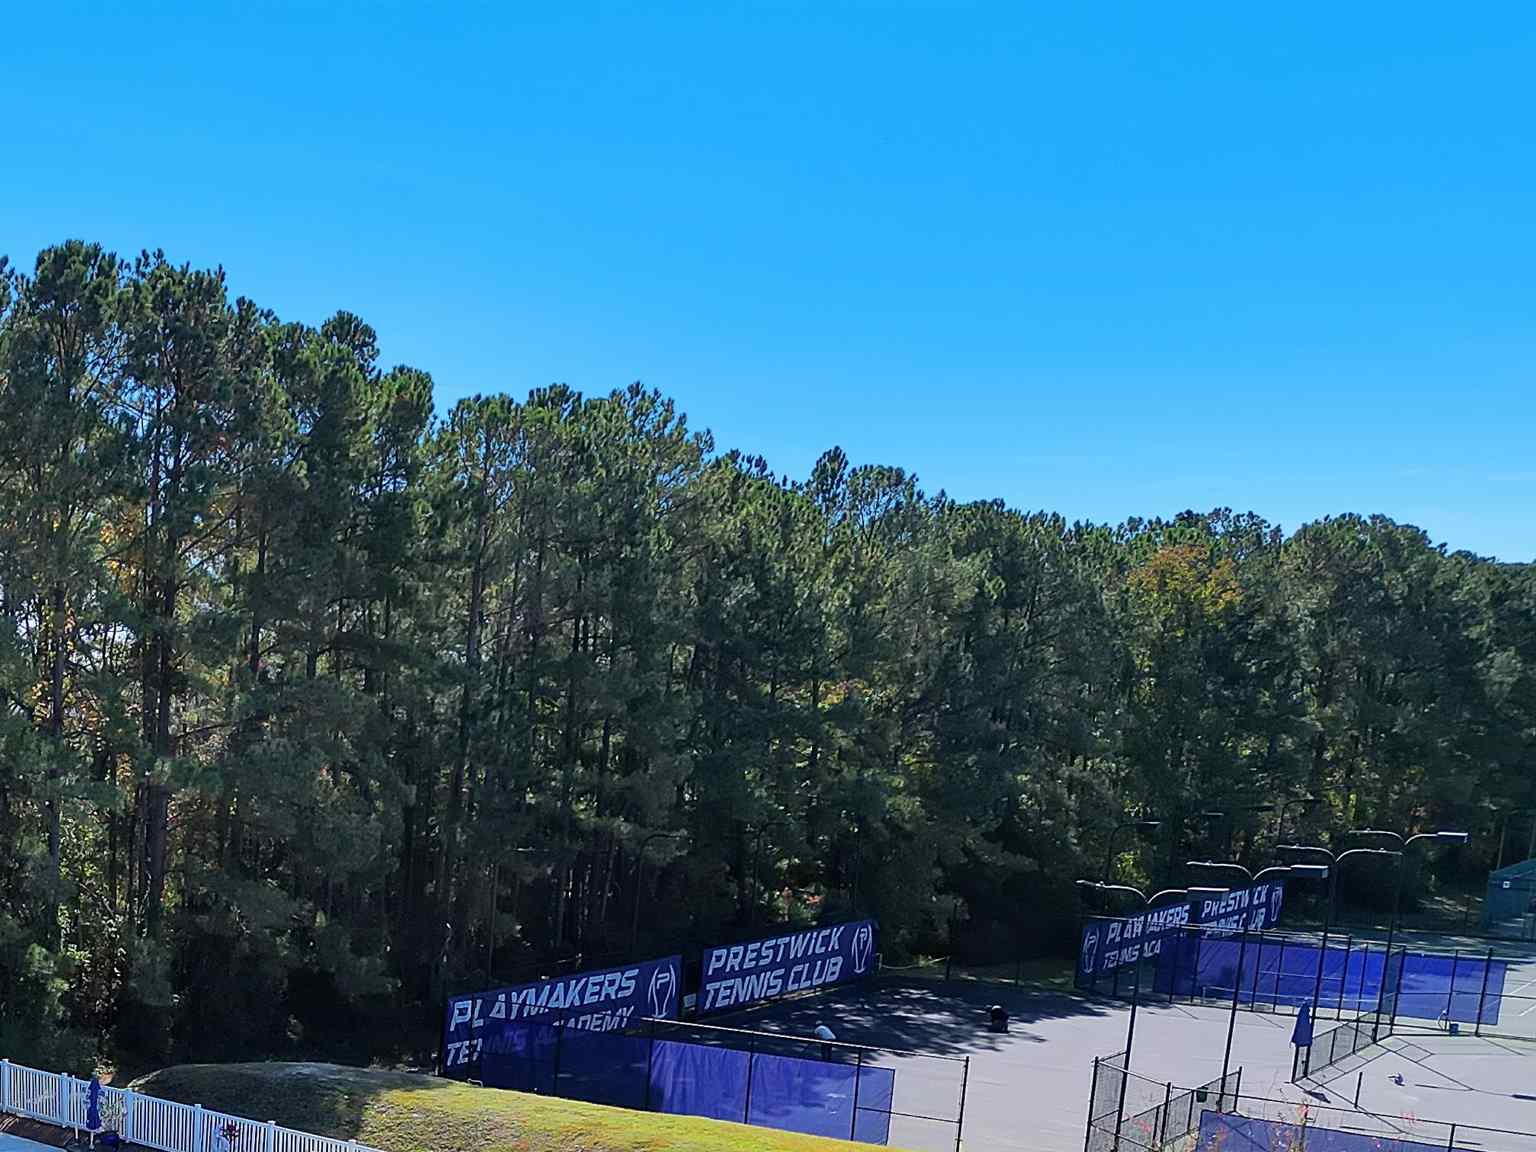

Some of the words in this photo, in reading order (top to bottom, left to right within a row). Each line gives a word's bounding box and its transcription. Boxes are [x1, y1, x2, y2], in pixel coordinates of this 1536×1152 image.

[1201, 884, 1270, 919] PRESTWCK
[707, 926, 845, 976] PRESTWICK
[449, 969, 639, 1031] PLAYMAKERS
[704, 968, 785, 1010] TENNIS
[787, 956, 844, 991] CLUB
